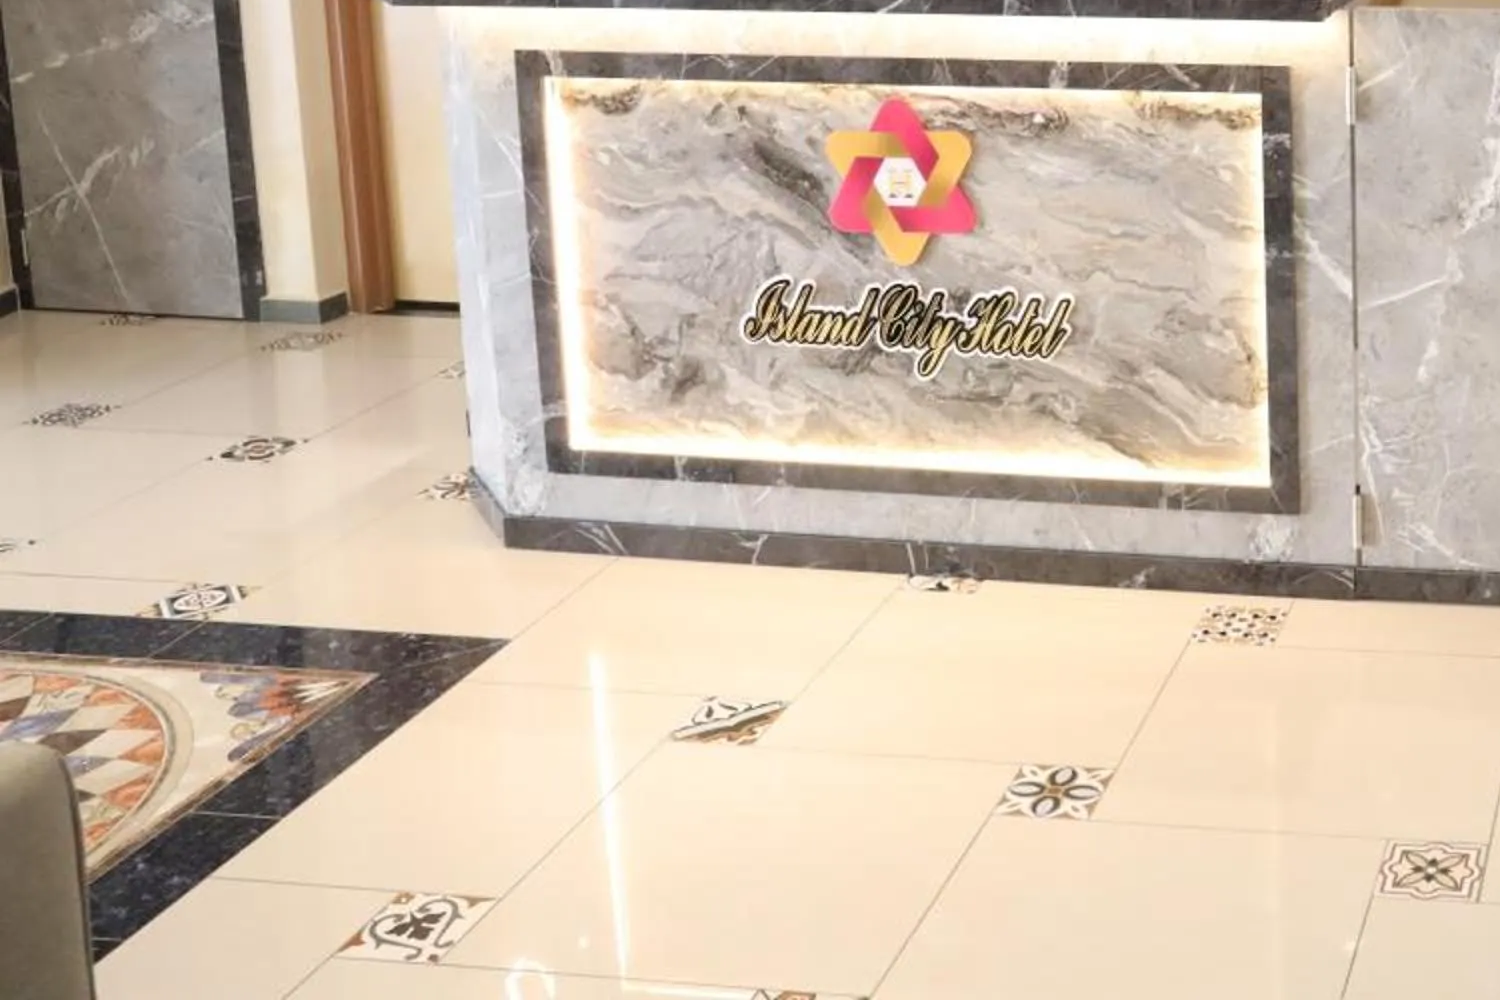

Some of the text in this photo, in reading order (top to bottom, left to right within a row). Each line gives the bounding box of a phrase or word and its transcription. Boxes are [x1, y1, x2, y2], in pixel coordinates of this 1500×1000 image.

[743, 278, 1072, 378] Island City Hotel
